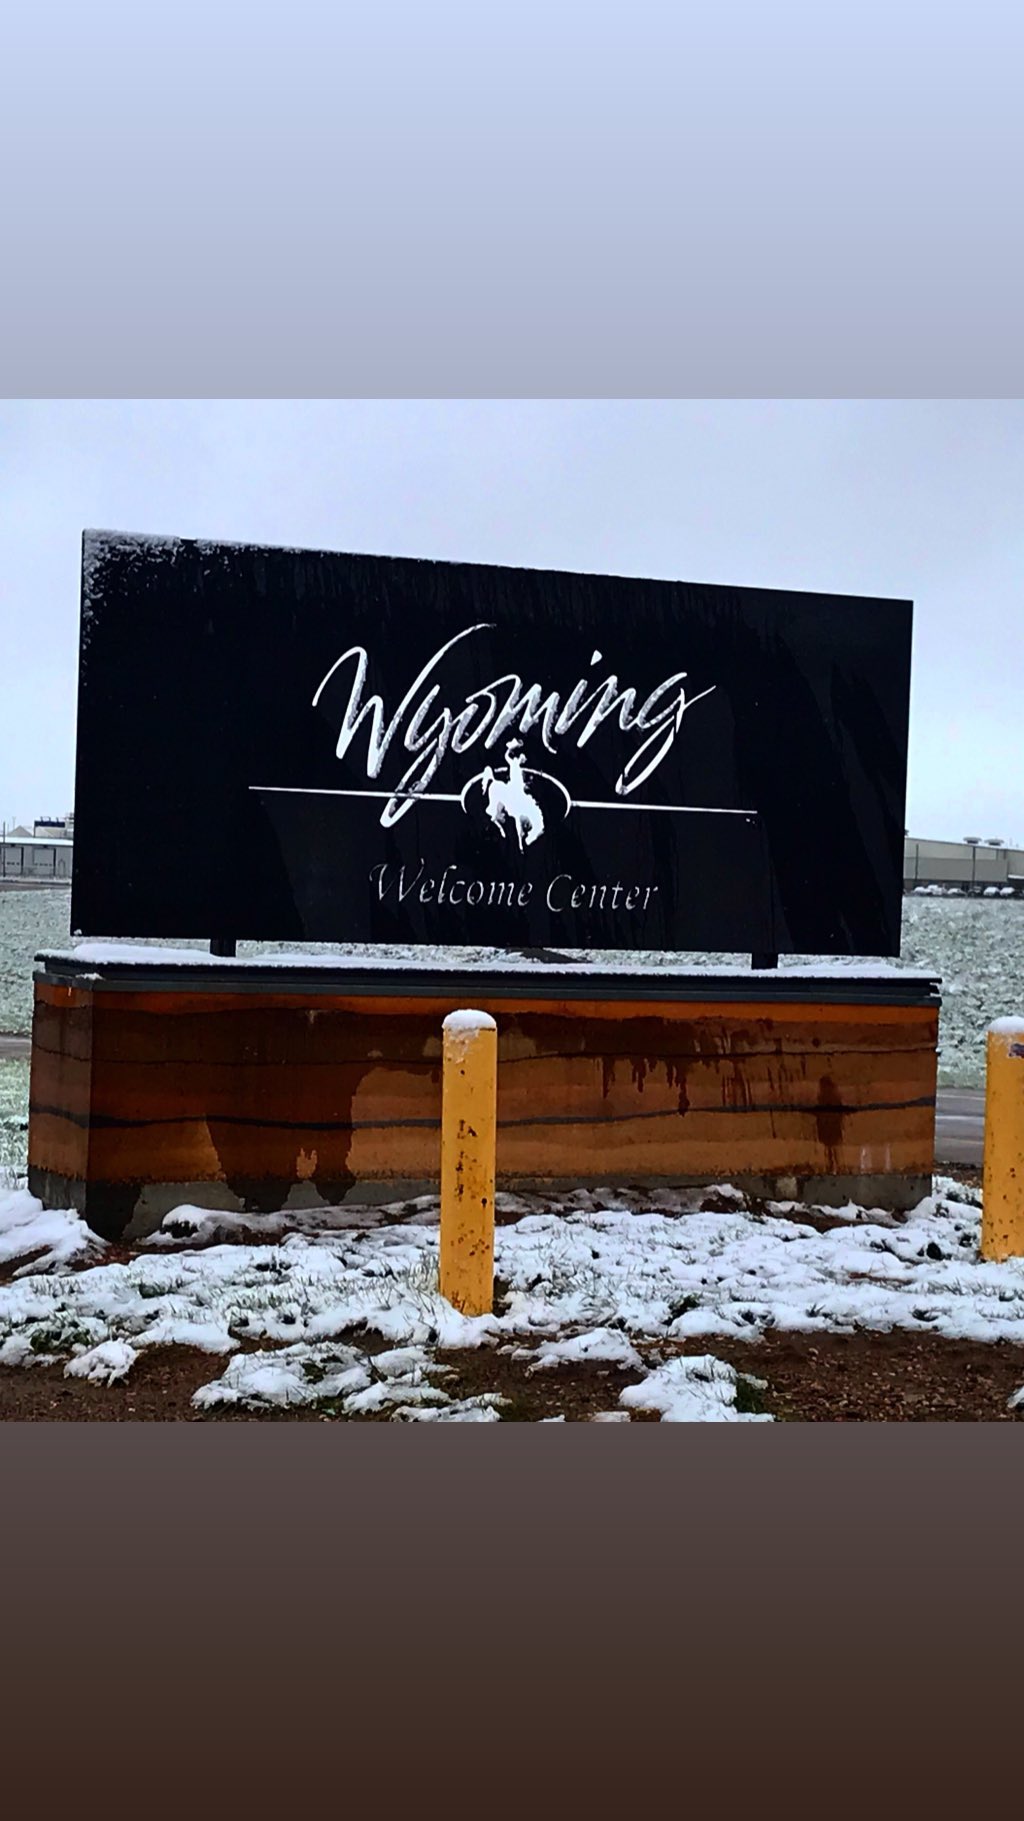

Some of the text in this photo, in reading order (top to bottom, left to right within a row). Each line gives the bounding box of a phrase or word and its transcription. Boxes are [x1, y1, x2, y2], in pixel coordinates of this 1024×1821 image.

[311, 622, 717, 828] Wyoming
[369, 858, 659, 912] Welcome Center
